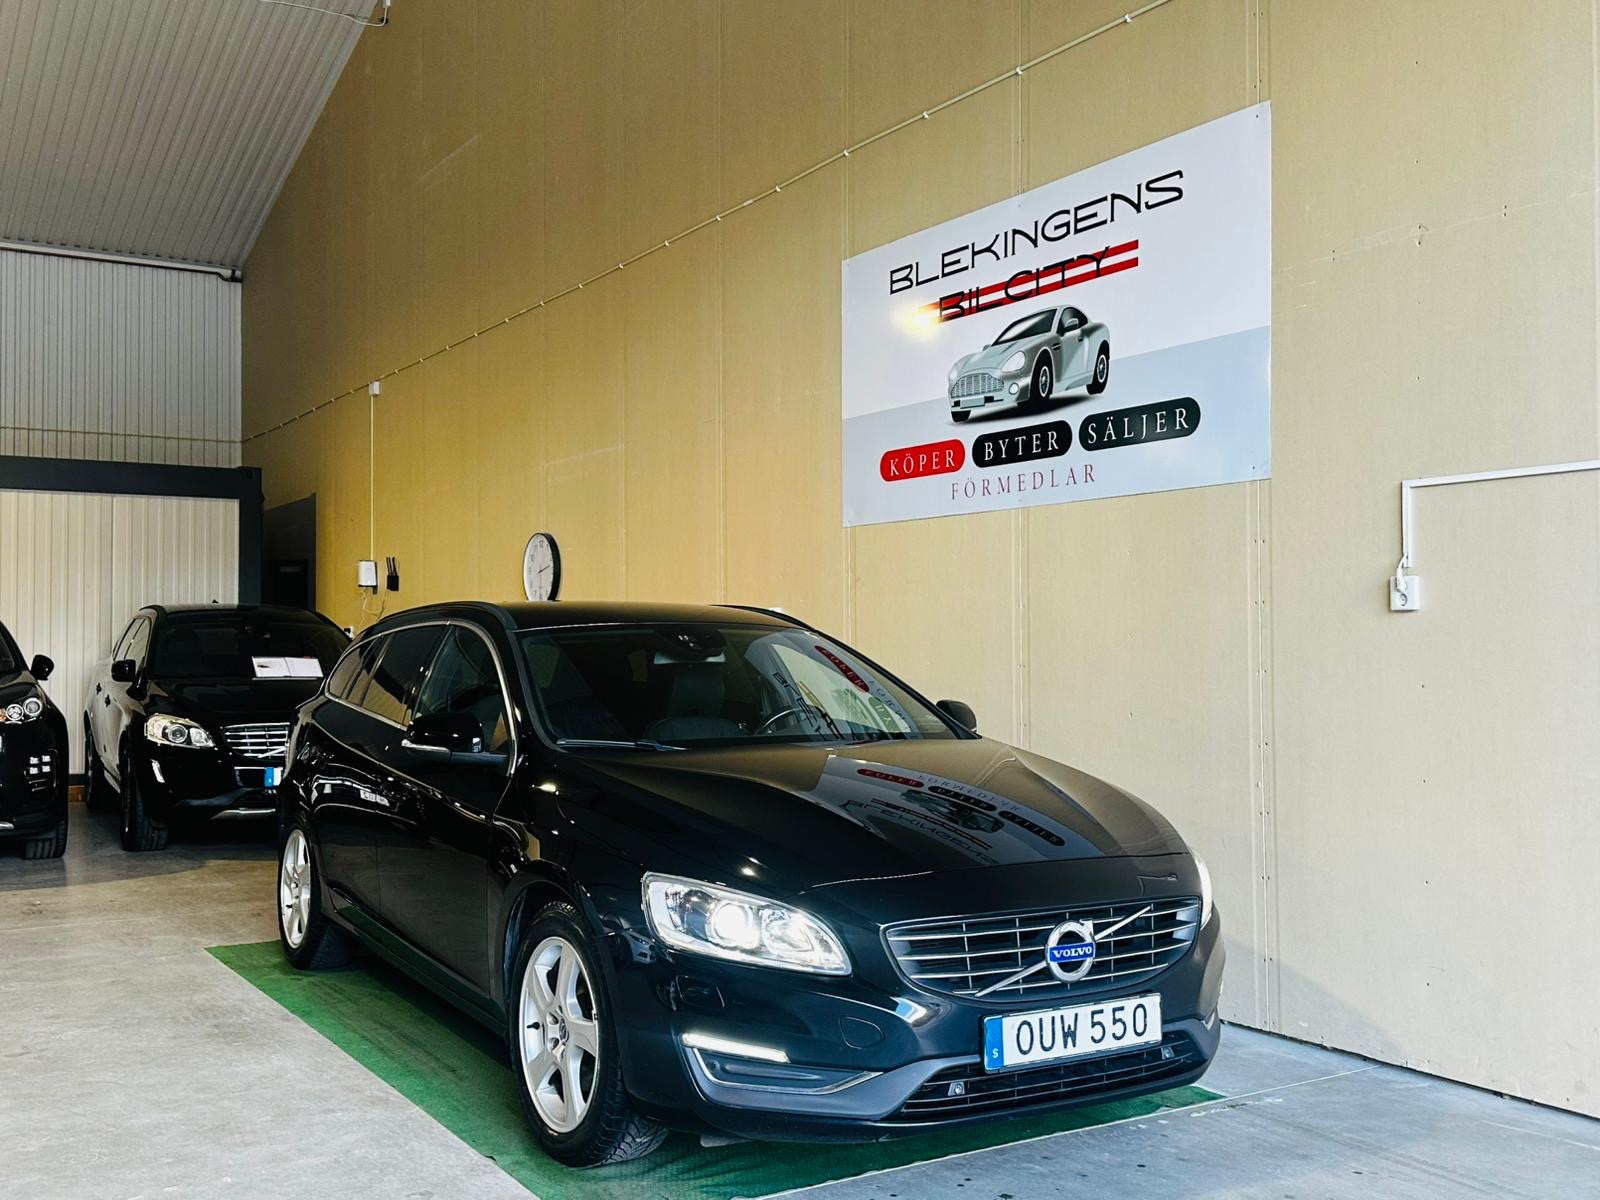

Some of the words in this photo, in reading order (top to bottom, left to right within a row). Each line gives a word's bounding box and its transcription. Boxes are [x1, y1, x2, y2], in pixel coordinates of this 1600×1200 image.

[889, 169, 1184, 295] BLEKINGENS
[939, 245, 1110, 321] BILCITY
[890, 449, 956, 476] KÖPER
[984, 430, 1059, 461] BYTER
[1087, 407, 1190, 444] SÄLJER
[951, 463, 1096, 500] FÖRMEDLAR
[1052, 946, 1092, 958] VOLVO
[992, 1048, 999, 1059] S
[1016, 1013, 1079, 1056] OUW
[1091, 1003, 1148, 1044] 550
